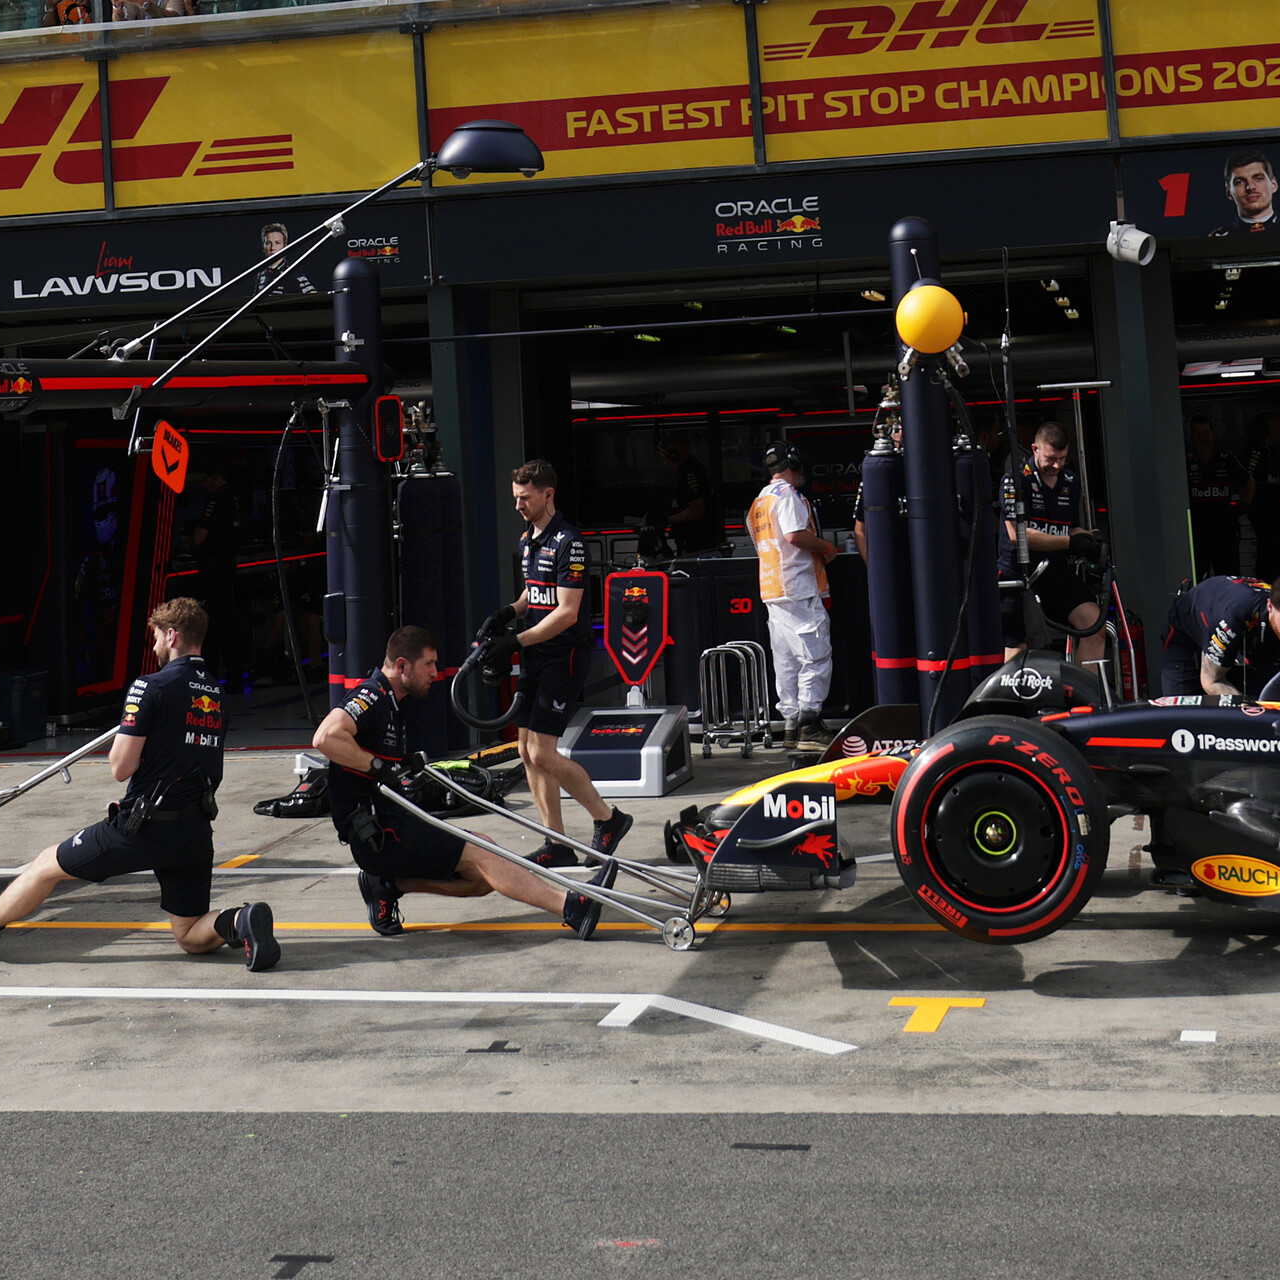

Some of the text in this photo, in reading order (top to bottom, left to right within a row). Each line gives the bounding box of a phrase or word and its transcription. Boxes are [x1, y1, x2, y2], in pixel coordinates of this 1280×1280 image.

[566, 99, 731, 138] FASTEST
[740, 93, 814, 126] PIT
[823, 85, 925, 119] STOP
[935, 63, 1203, 110] CHAMPIONS
[1157, 173, 1190, 218] 1
[715, 196, 820, 217] ORACLE
[716, 219, 773, 236] Red Bull
[347, 236, 399, 248] ORACLE
[717, 238, 823, 253] RACING
[95, 241, 133, 277] Liam
[14, 267, 222, 299] LAWSON
[163, 428, 183, 454] BRAKES
[1191, 486, 1230, 498] Red Bull
[530, 586, 556, 605] Bull
[729, 597, 753, 614] 30
[188, 681, 220, 694] ORACLE
[1000, 673, 1053, 690] Hard Rock
[185, 712, 206, 727] Red
[185, 731, 211, 746] Mobil
[988, 734, 1085, 806] P ZERO
[763, 793, 835, 821] Mobil
[1217, 865, 1279, 887] RAUCH
[917, 884, 969, 928] PIRELLI
